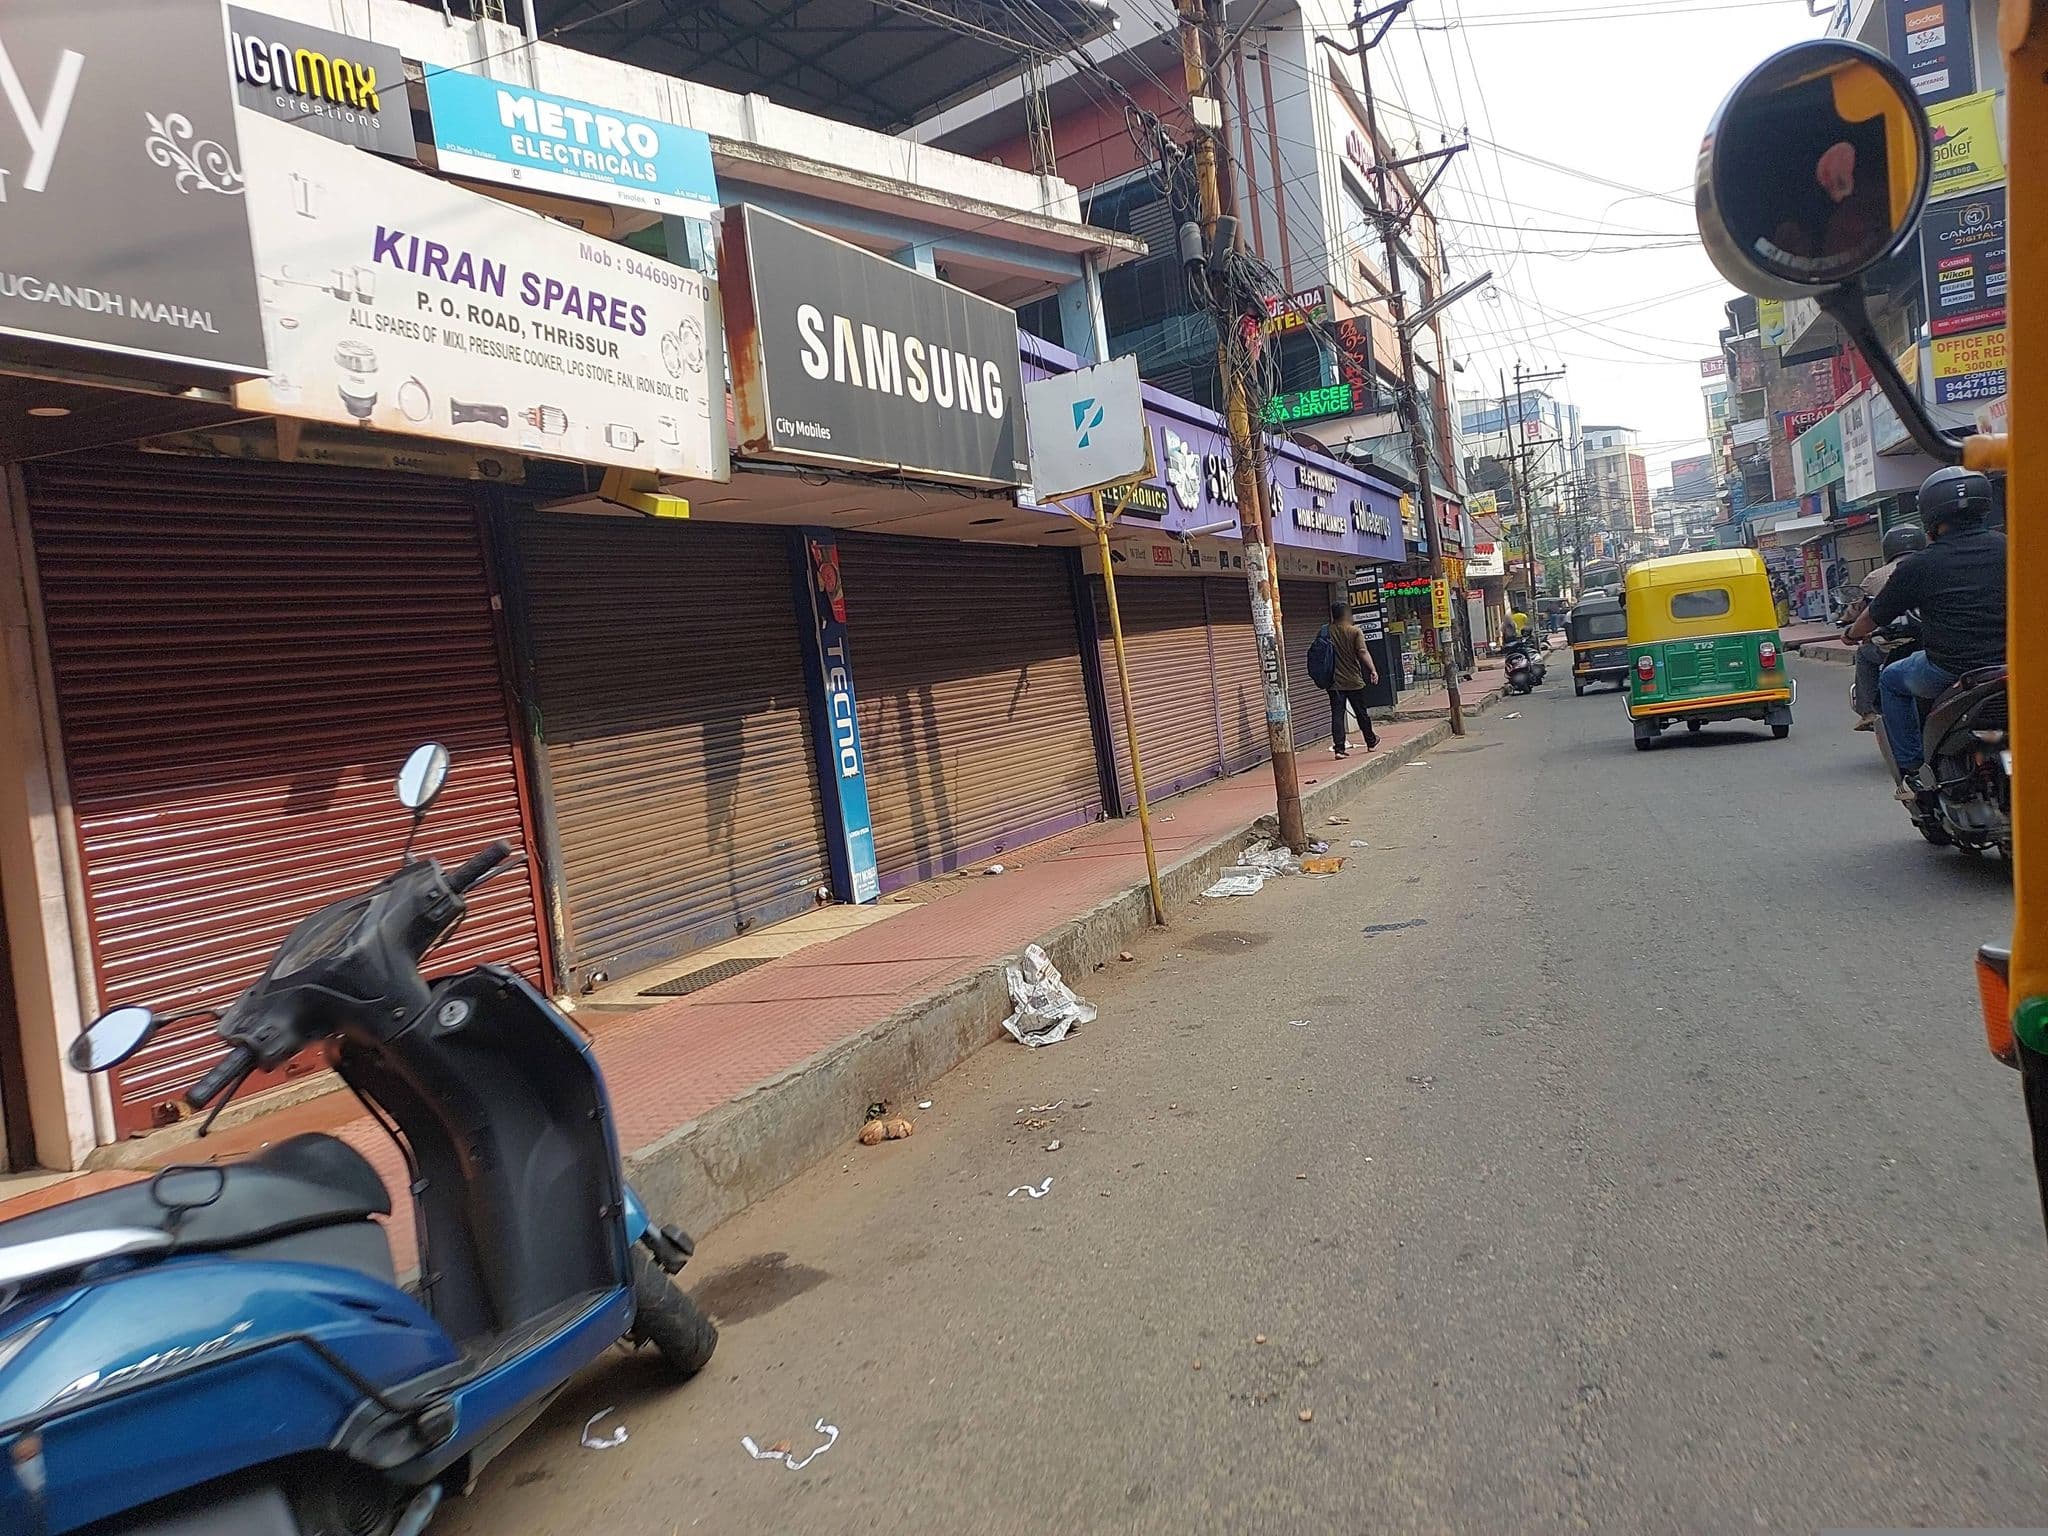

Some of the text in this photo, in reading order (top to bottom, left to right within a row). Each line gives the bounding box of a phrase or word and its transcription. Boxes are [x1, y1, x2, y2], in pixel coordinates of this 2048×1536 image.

[275, 95, 381, 130] creations
[496, 88, 660, 160] METRO
[510, 134, 658, 184] ELECTRICALS
[1954, 231, 1999, 246] DIGITAL
[579, 241, 612, 269] Mob
[625, 253, 711, 303] 9446997710
[1940, 256, 1970, 269] Canon
[1941, 268, 1971, 281] Nikon
[372, 225, 648, 337] KIRAN SPARES
[129, 296, 220, 335] MAHAL
[417, 290, 434, 313] P.
[440, 296, 461, 320] O.
[467, 303, 527, 340] ROAD,
[349, 307, 373, 330] ALL
[374, 313, 420, 340] SPARES
[422, 325, 437, 344] OF
[469, 335, 522, 364] PRESSURE
[523, 348, 566, 377] COOKER,
[566, 359, 585, 377] LPG
[585, 363, 617, 386] STOVE,
[616, 371, 636, 392] FAN,
[636, 375, 655, 395] IRON
[675, 386, 689, 403] ETC
[796, 303, 1005, 420] SAMSUNG
[1936, 336, 1983, 353] OFFICE
[1953, 349, 1980, 364] FOR
[1943, 366, 1961, 375] Rs.
[1965, 360, 1993, 372] 3000
[1291, 397, 1350, 418] SERVICE
[776, 417, 831, 440] City Mobiles
[1433, 581, 1445, 621] HOTEL
[1693, 641, 1715, 650] TVS
